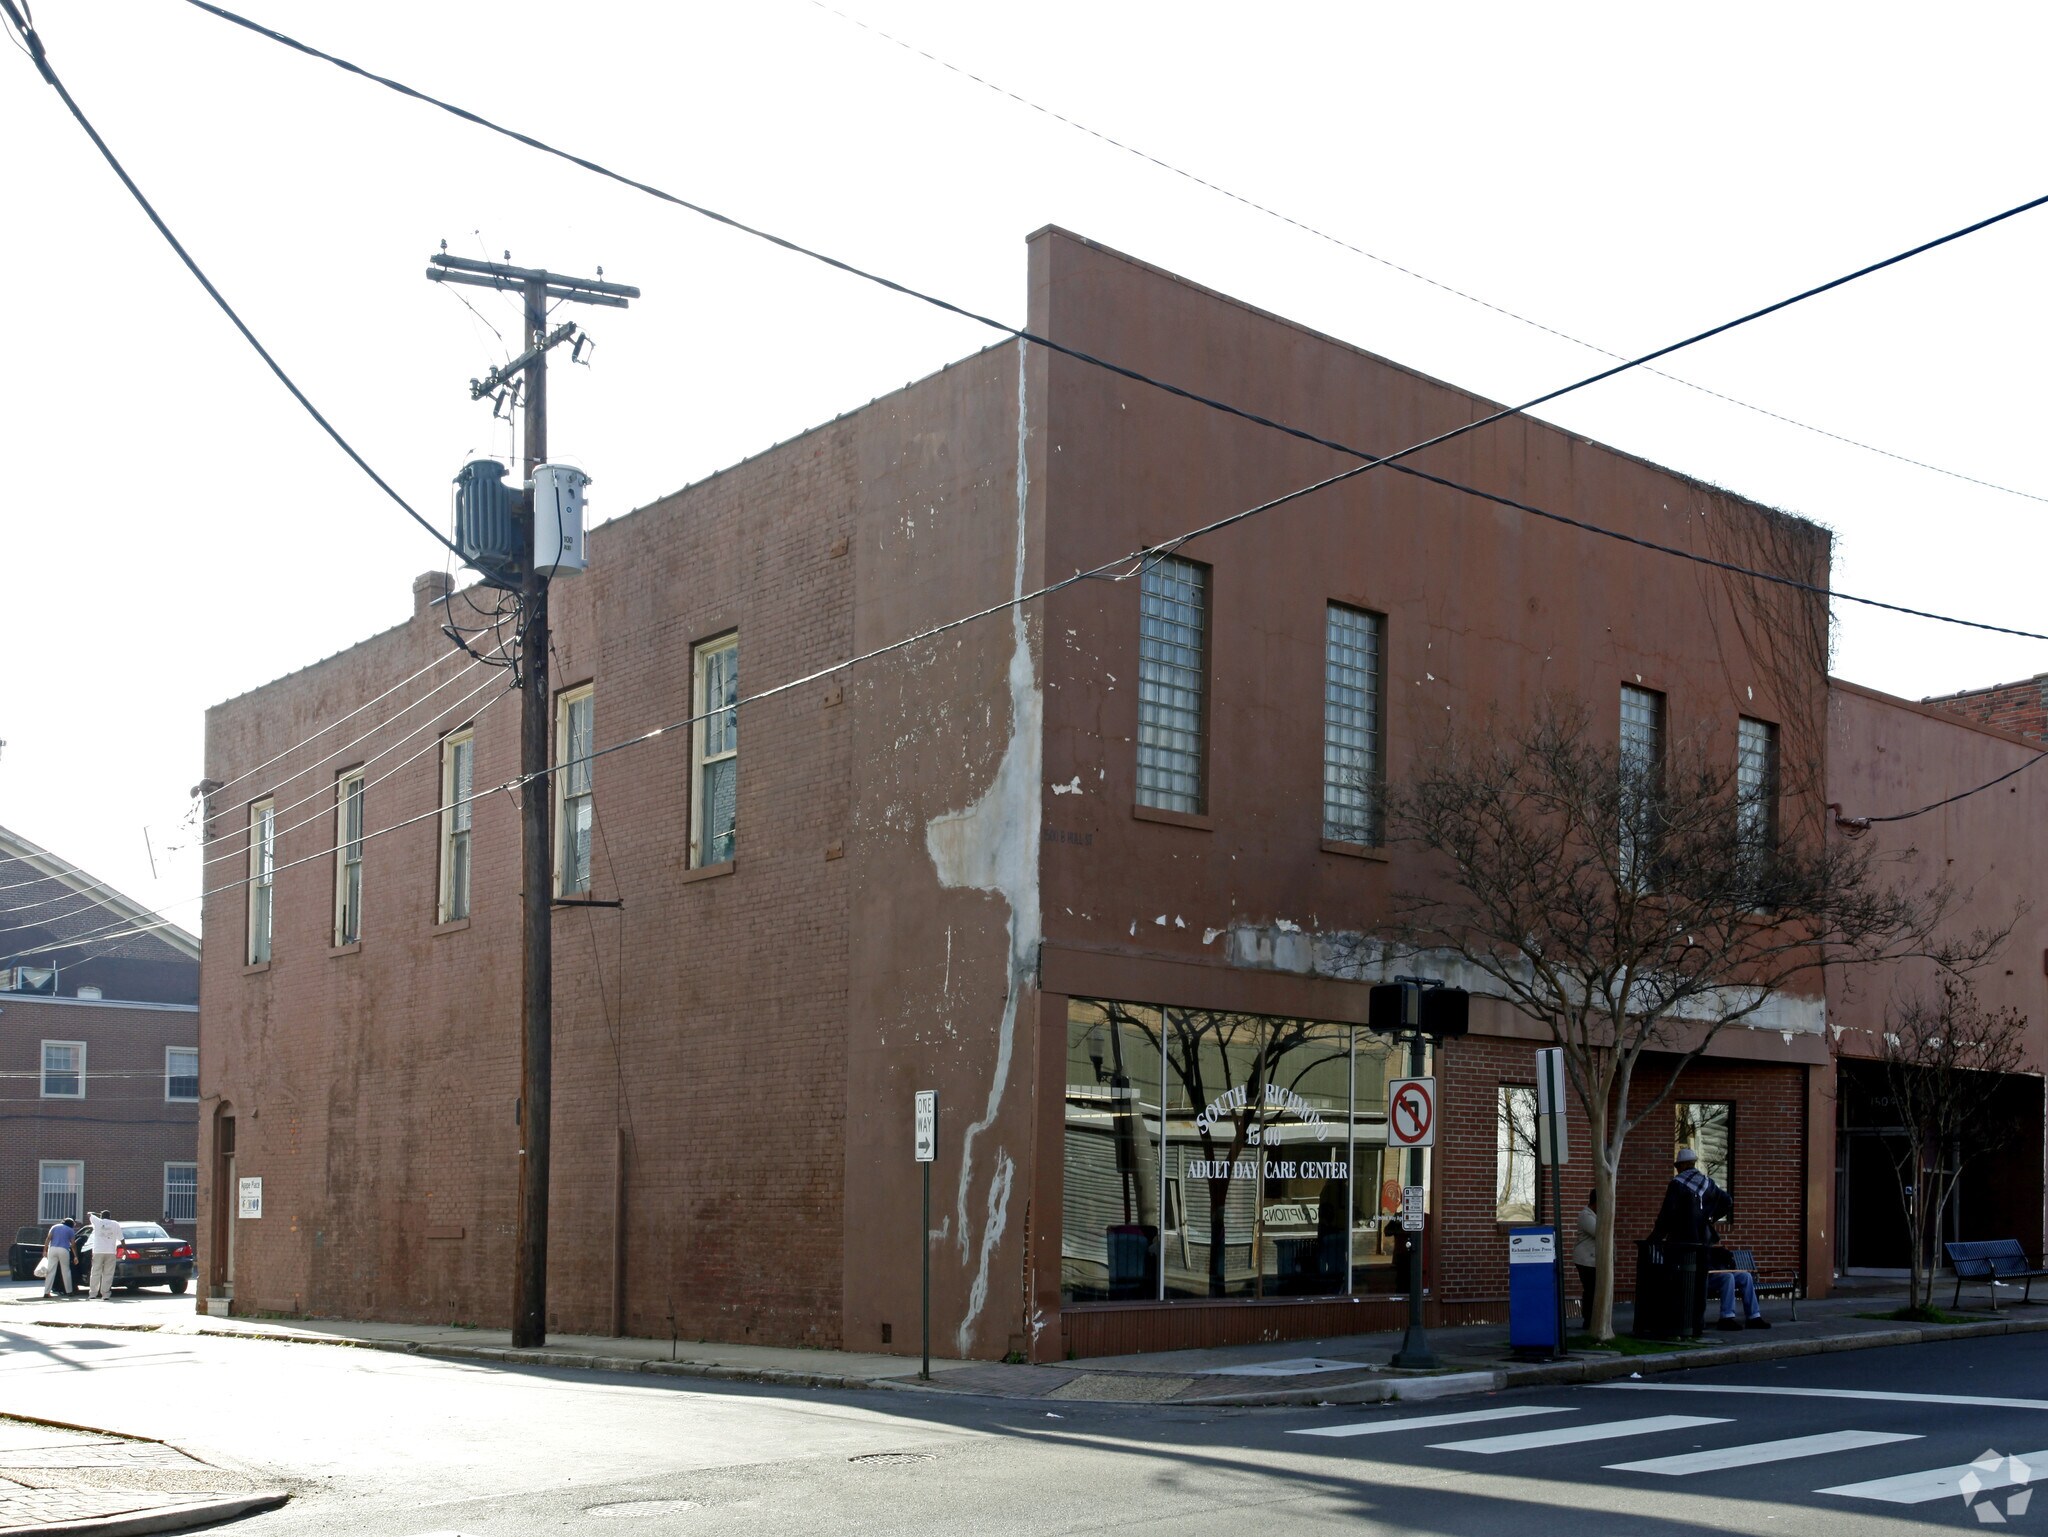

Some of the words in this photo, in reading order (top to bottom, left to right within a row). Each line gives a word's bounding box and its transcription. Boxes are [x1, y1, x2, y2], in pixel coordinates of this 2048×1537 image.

[917, 1098, 932, 1114] ONE
[1196, 1084, 1247, 1135] SOUTH
[1264, 1083, 1329, 1142] RICHMOND
[917, 1117, 932, 1133] WAY
[1187, 1160, 1230, 1179] ADULT
[1233, 1160, 1259, 1179] DAY
[1264, 1160, 1297, 1179] CARE
[1300, 1160, 1348, 1179] CENTER
